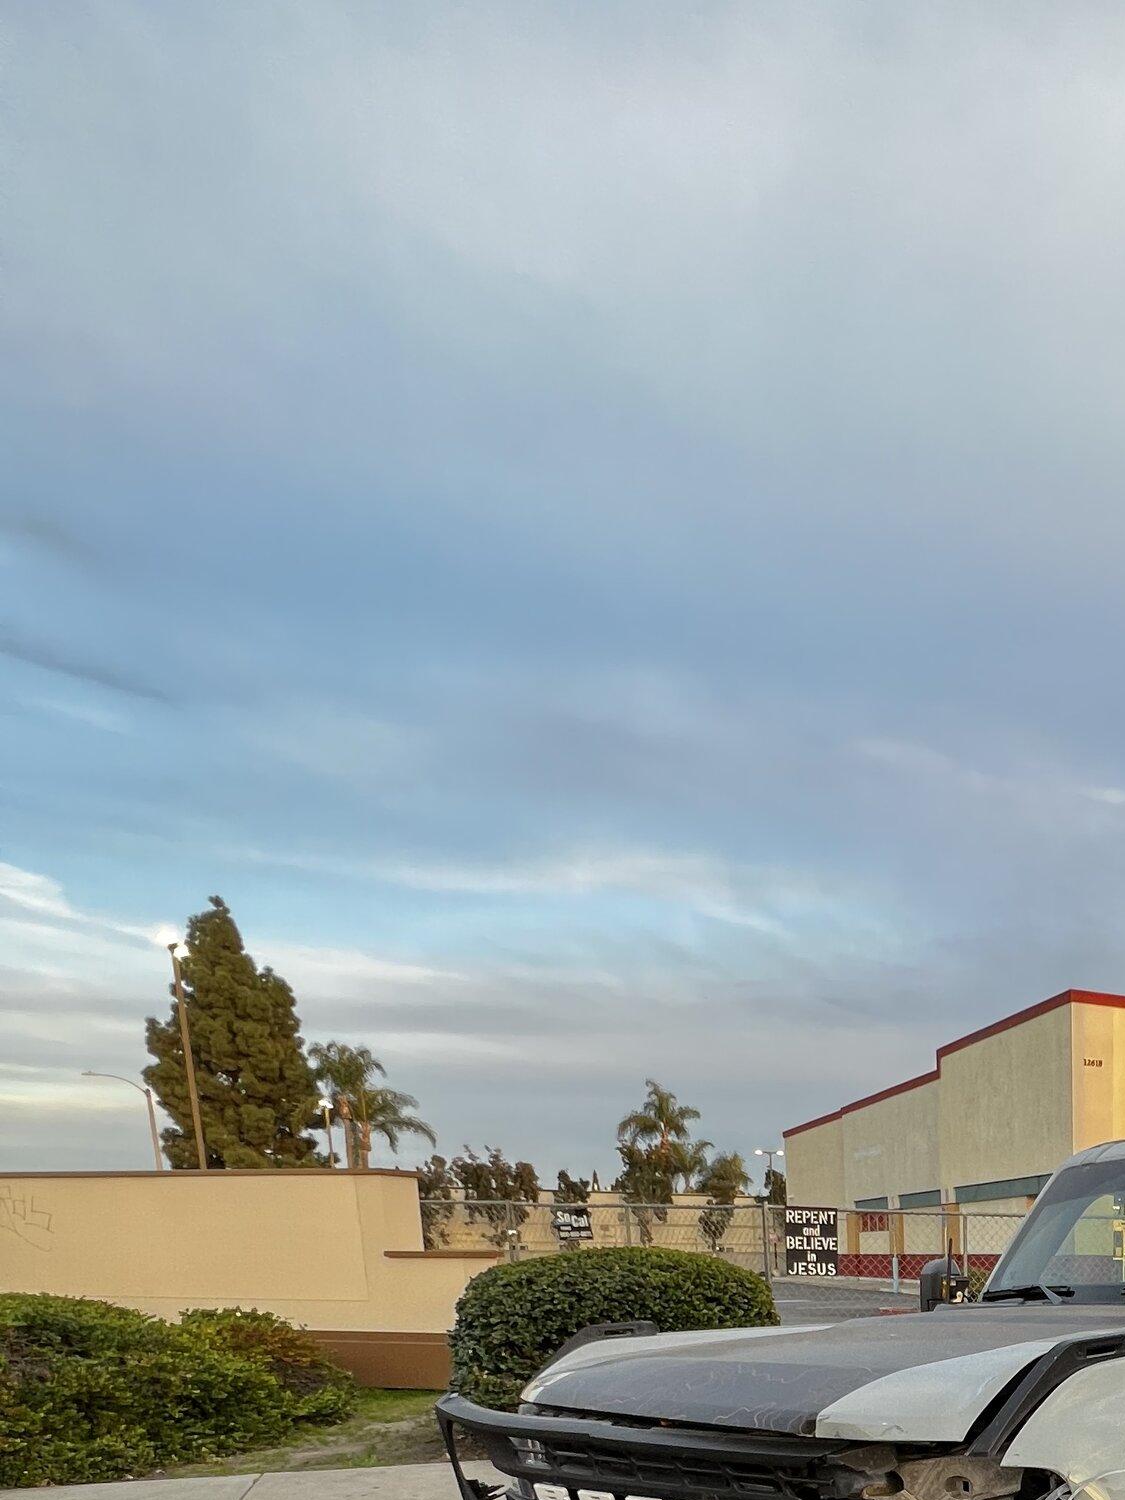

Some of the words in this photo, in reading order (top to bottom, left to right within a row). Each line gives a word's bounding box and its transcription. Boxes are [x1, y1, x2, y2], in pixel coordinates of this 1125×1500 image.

[785, 1209, 836, 1225] REPENT
[802, 1224, 821, 1236] and
[786, 1235, 838, 1251] BELIEVE
[807, 1250, 817, 1262] in
[788, 1261, 837, 1276] JESUS
